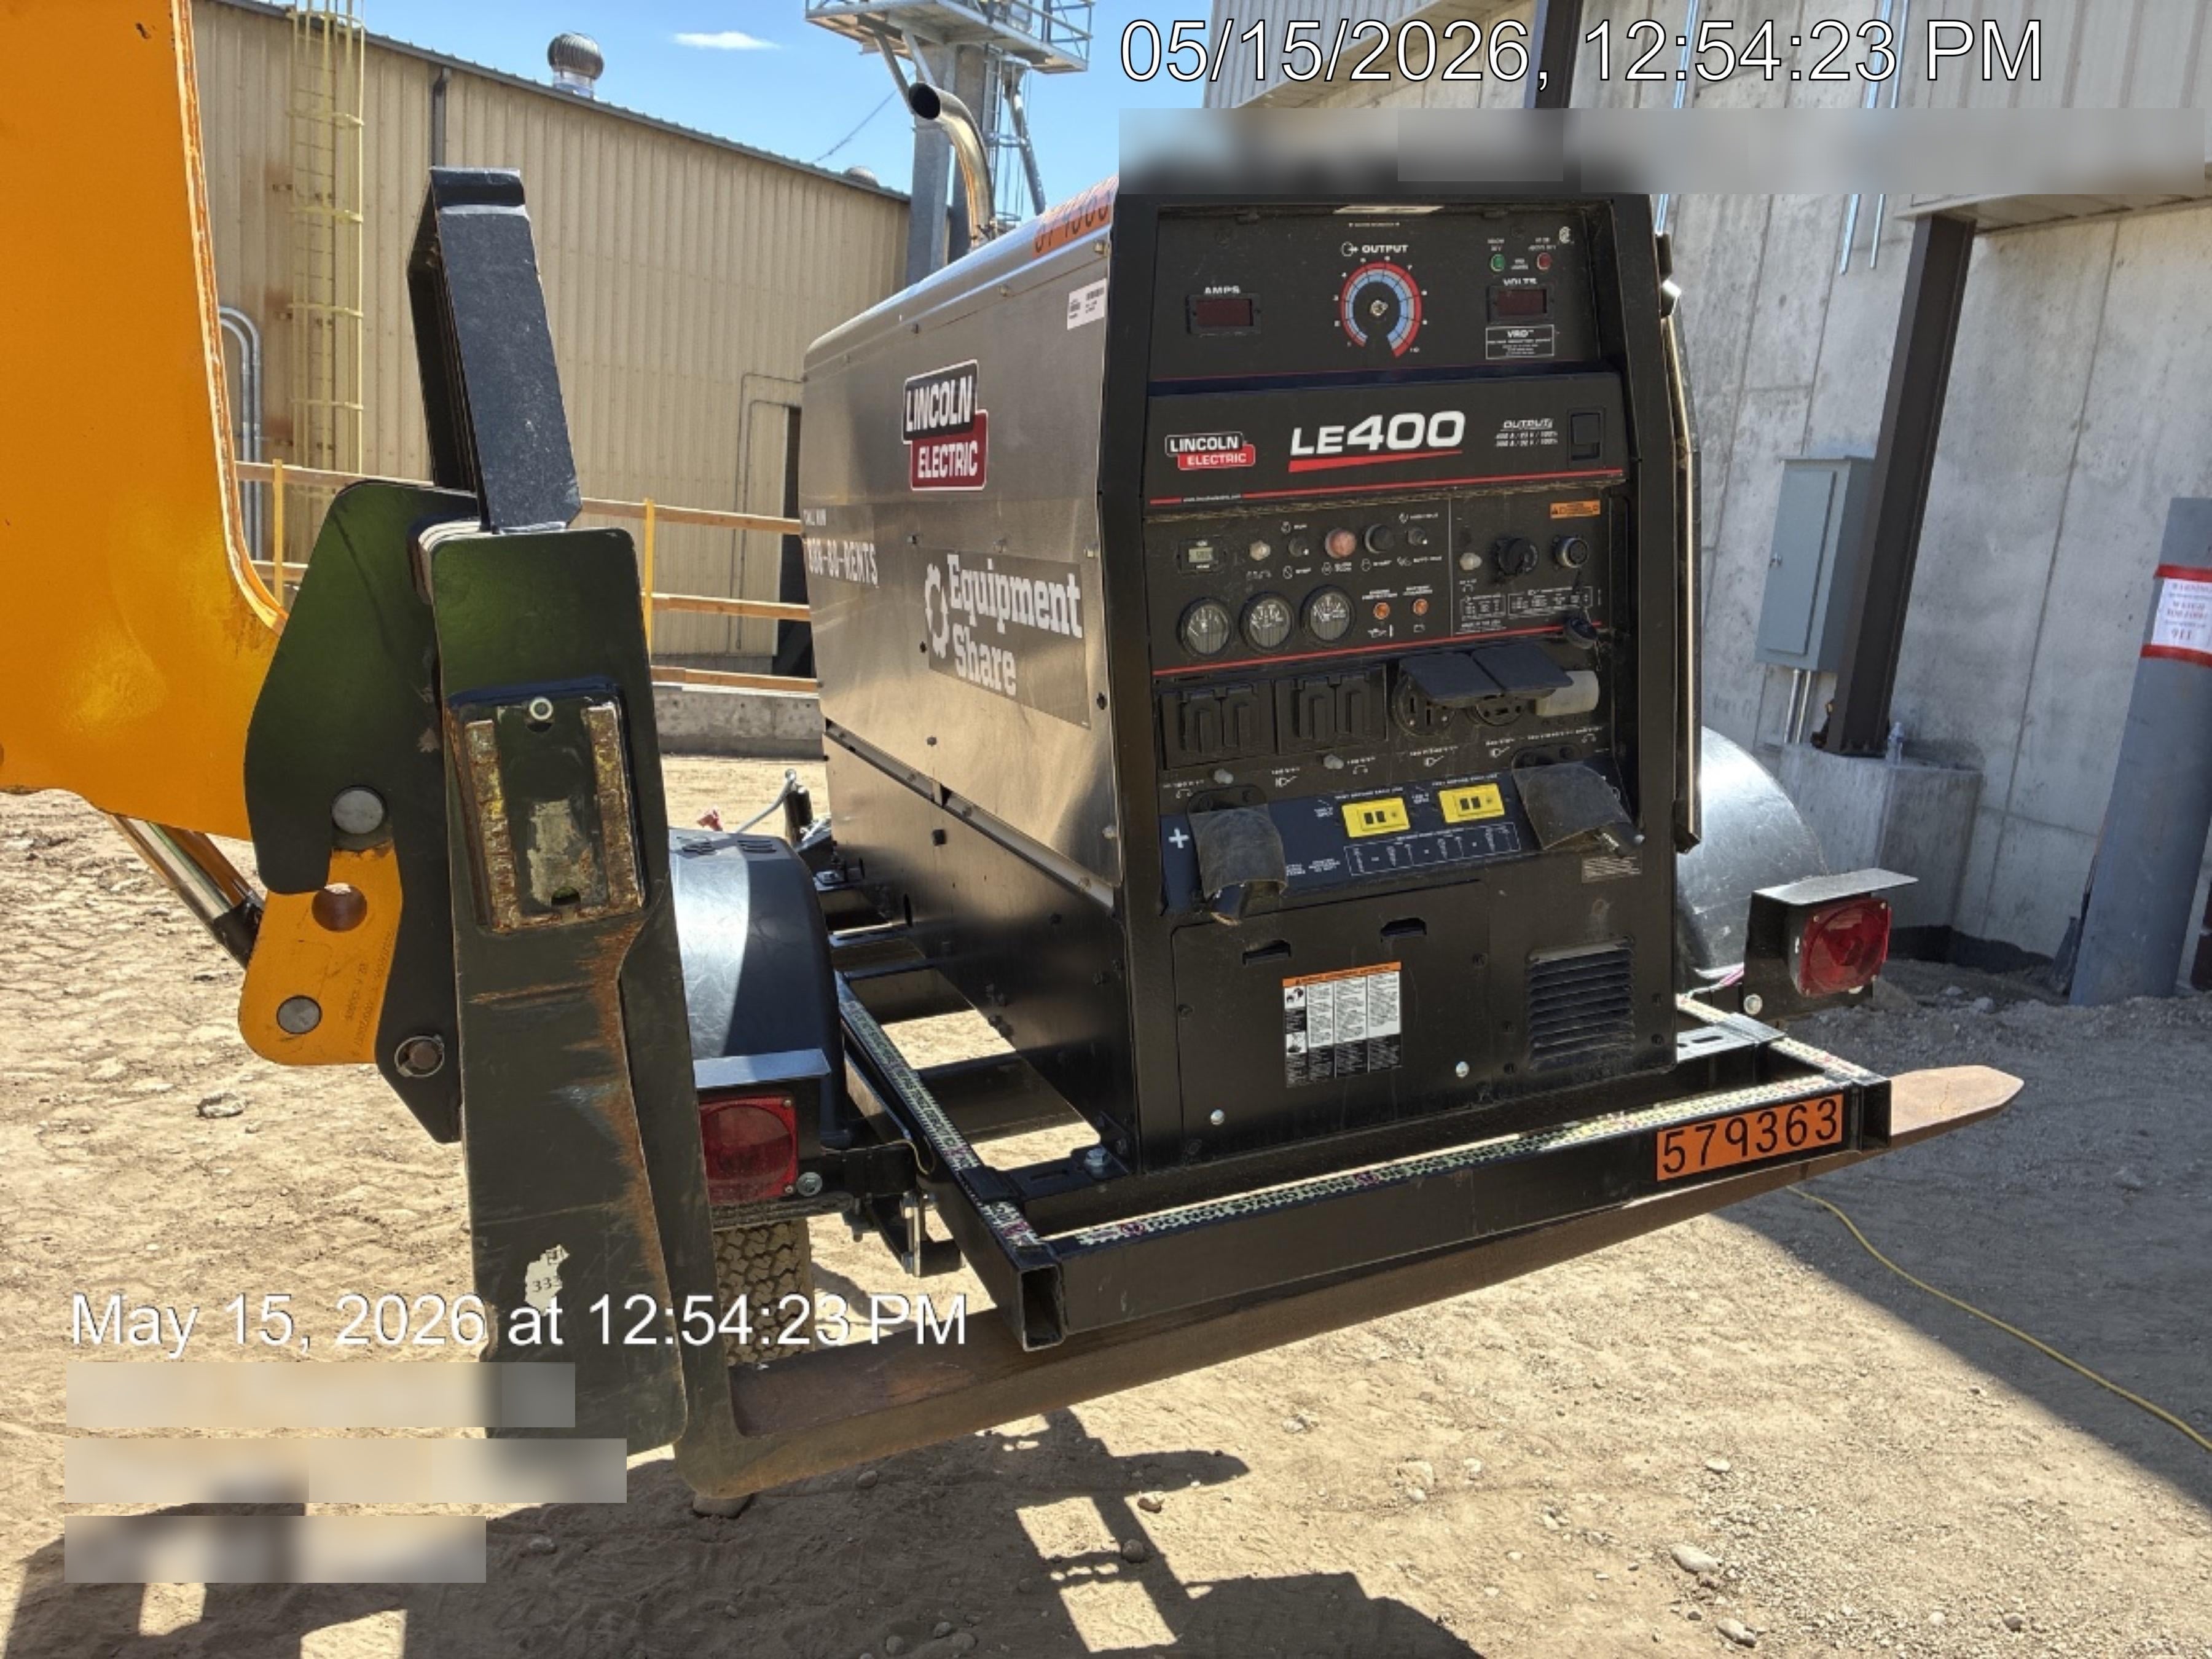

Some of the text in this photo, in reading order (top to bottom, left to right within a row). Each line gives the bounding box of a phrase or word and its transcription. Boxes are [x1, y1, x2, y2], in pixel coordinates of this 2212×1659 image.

[1361, 244, 1409, 253] OUTPUT
[1204, 285, 1240, 294] AMPS
[906, 375, 972, 432] LINCOLN
[1170, 436, 1239, 452] LINCOLN
[1290, 410, 1466, 456] LE400
[918, 440, 978, 479] ELECTRIC
[1186, 453, 1247, 466] ELECTRIC
[947, 553, 1083, 638] Equipment
[952, 622, 1016, 696] Share
[1663, 1098, 1837, 1174] 579363
